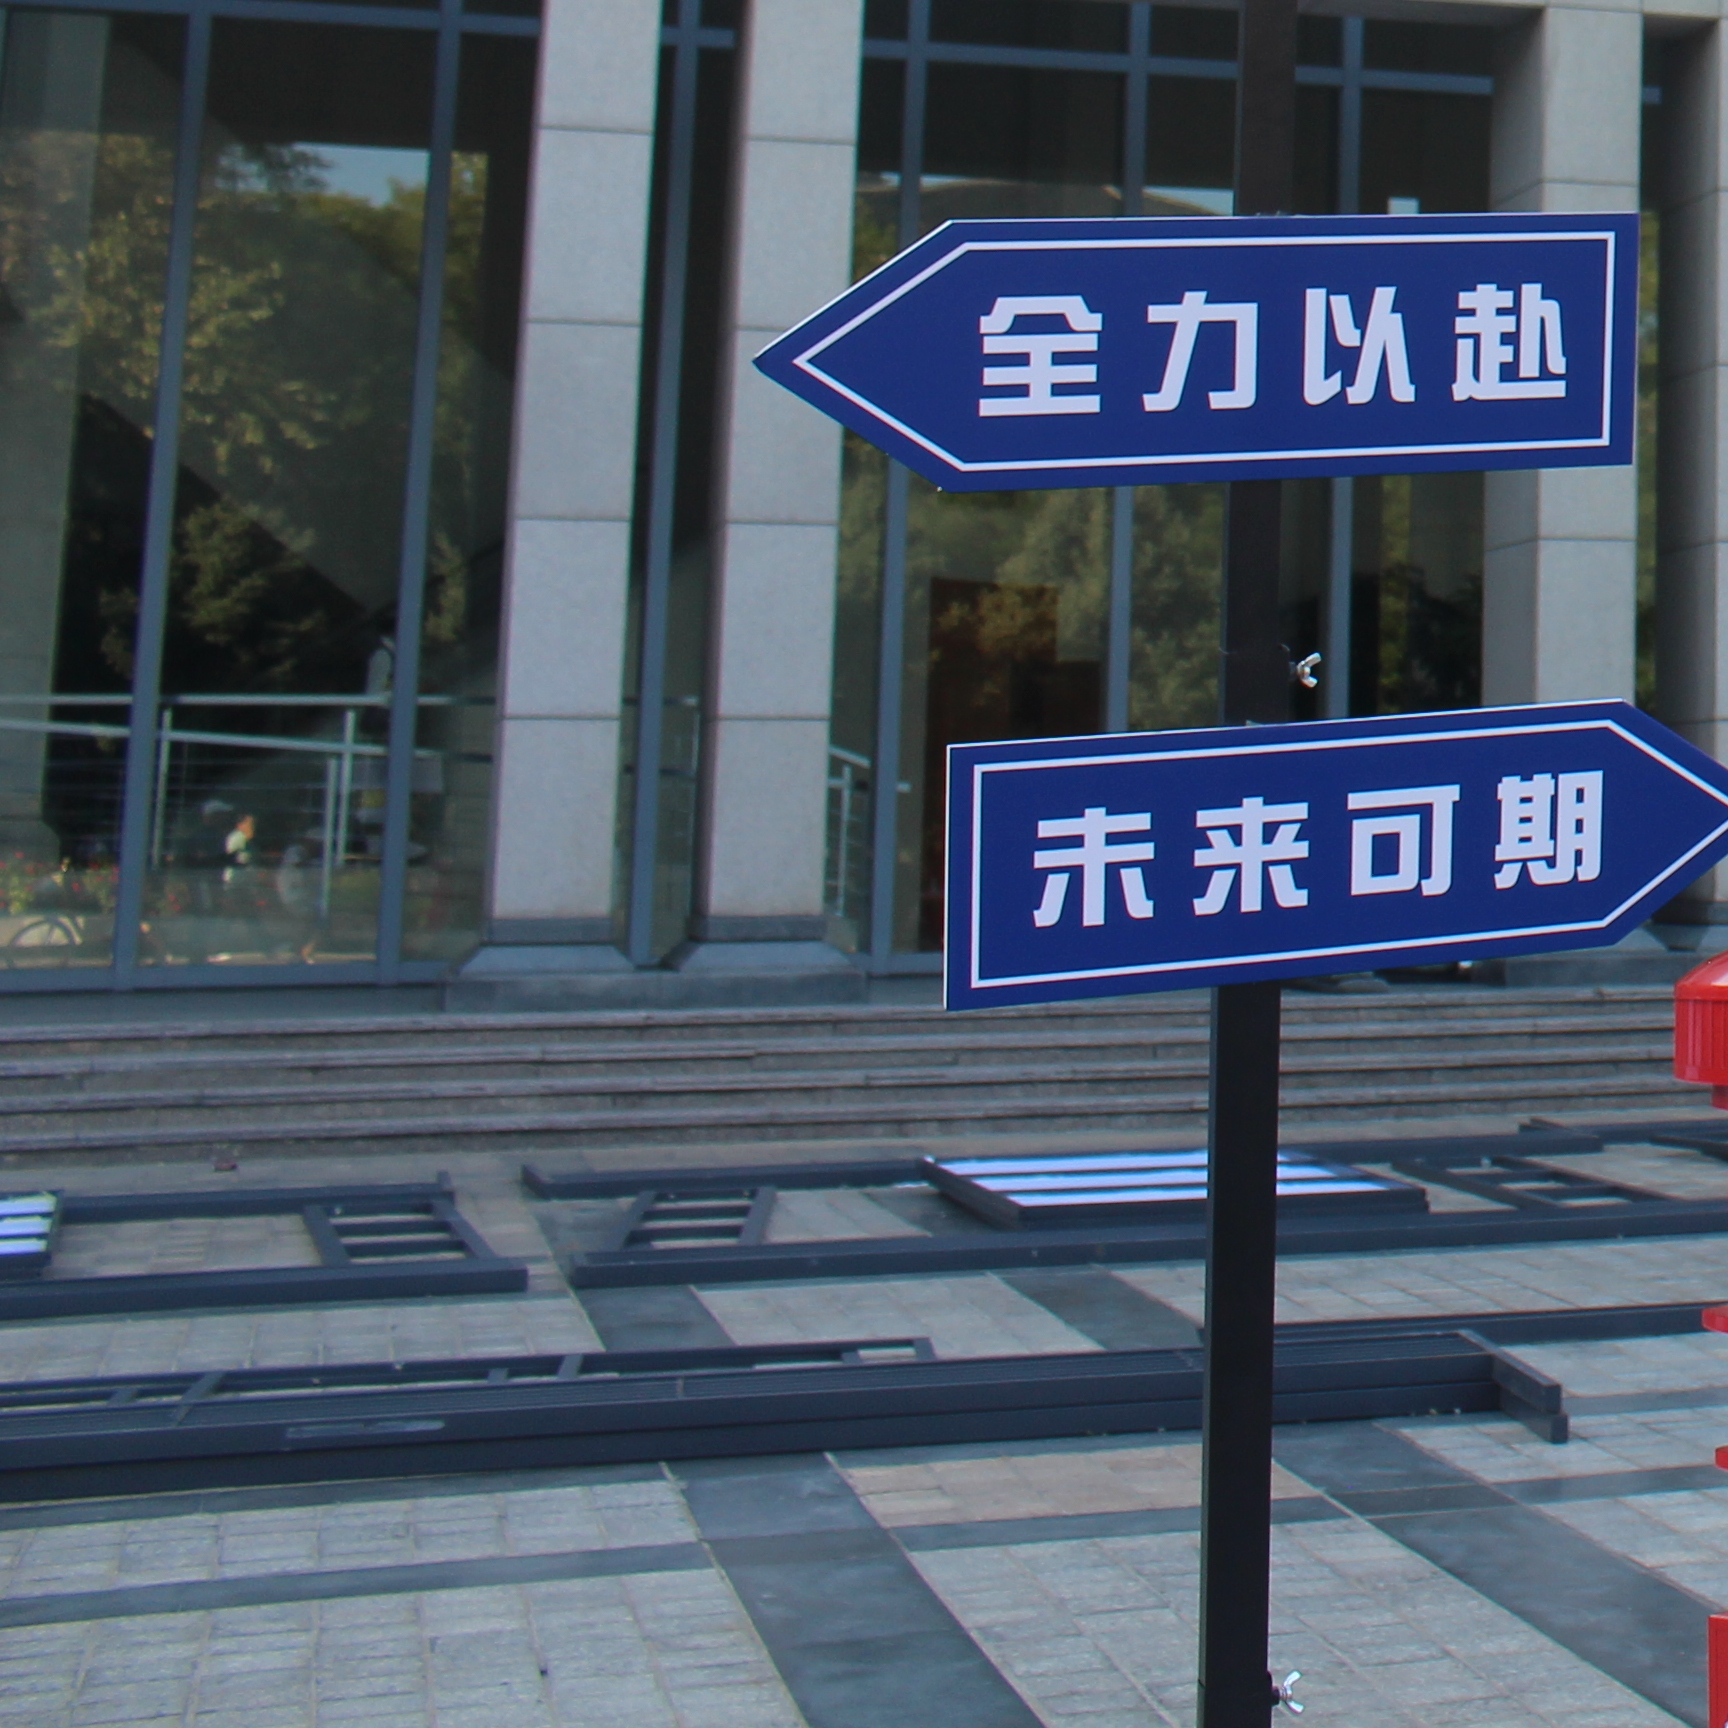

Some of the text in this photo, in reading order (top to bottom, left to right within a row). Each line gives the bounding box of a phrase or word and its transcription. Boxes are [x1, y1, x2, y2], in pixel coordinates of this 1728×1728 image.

[978, 283, 1566, 417] 全力以赴
[1033, 769, 1604, 927] 未来可期
